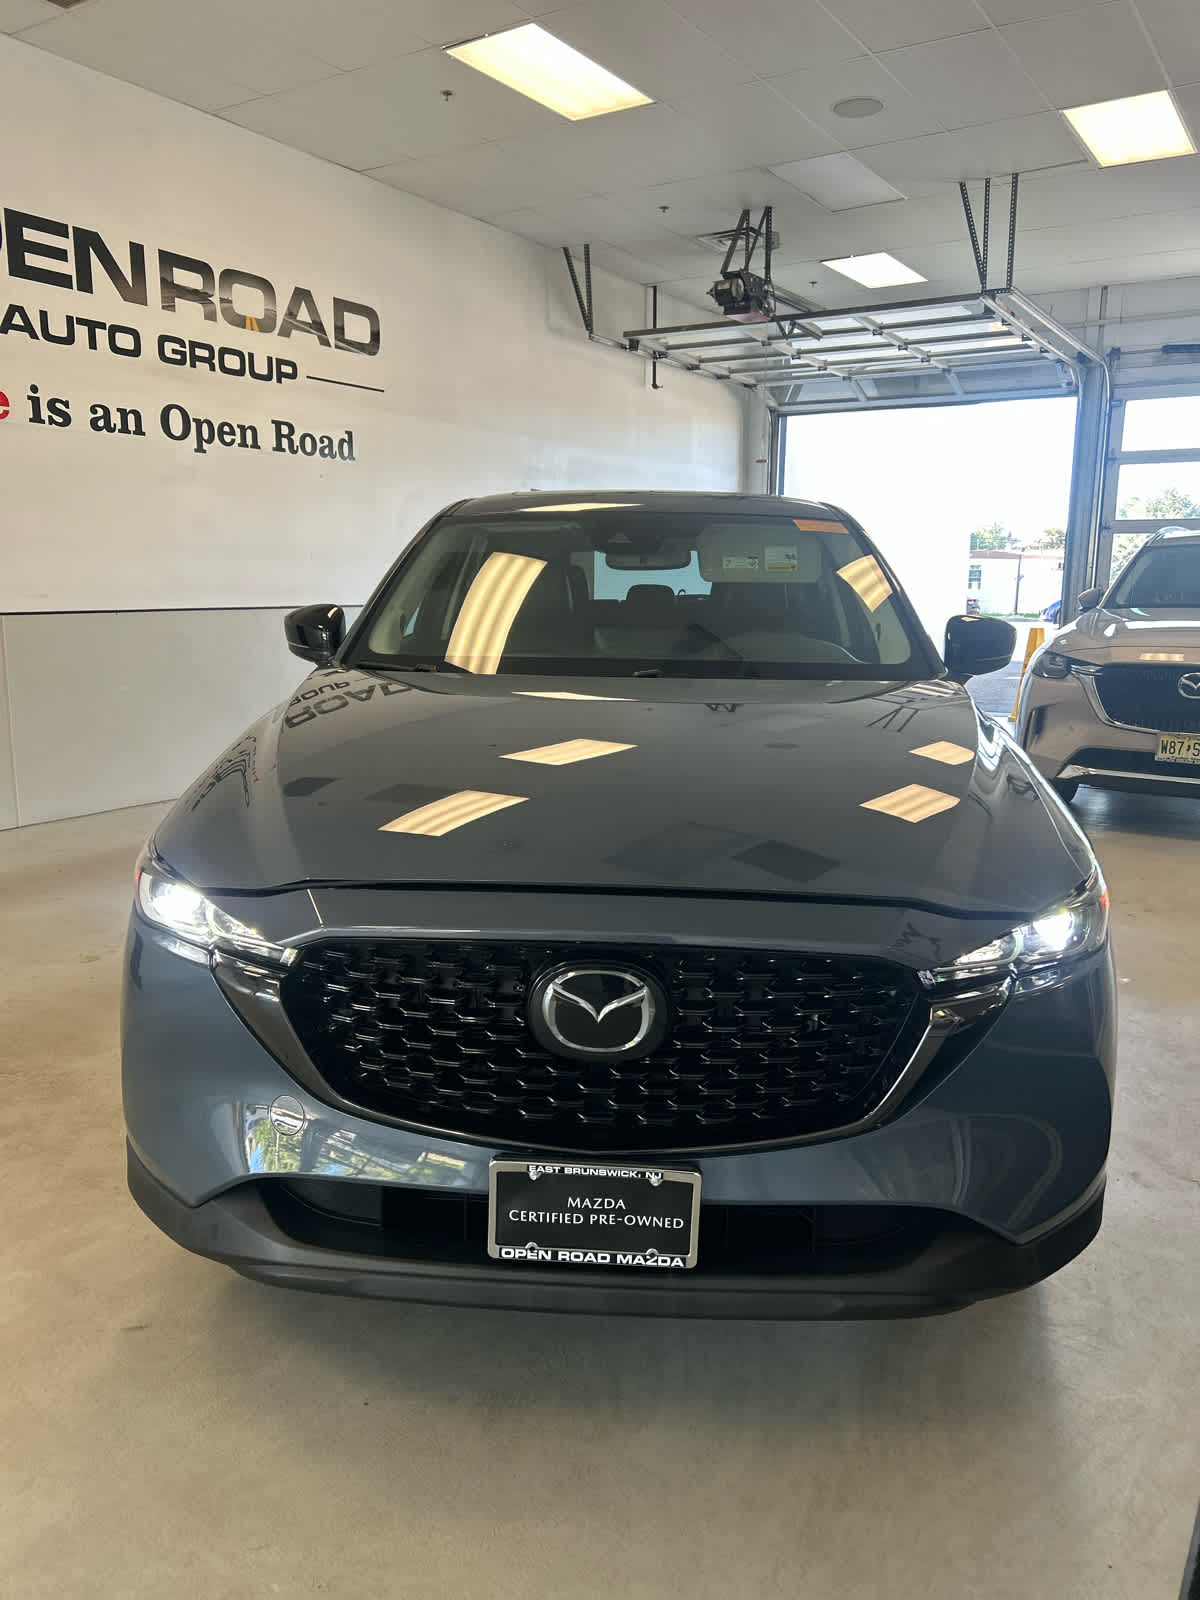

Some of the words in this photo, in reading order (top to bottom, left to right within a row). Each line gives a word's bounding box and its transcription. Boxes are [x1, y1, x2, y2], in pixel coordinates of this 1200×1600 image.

[0, 207, 148, 307] EN
[157, 248, 381, 356] ROAD
[0, 304, 142, 358] AUTO
[157, 334, 298, 384] GROUP
[26, 384, 72, 428] is
[89, 401, 146, 437] an
[160, 403, 261, 453] Open
[271, 419, 356, 461] Road
[528, 1165, 561, 1174] EAST
[564, 1167, 642, 1178] BRUNSWICK,
[645, 1171, 663, 1180] NJ
[567, 1197, 626, 1210] MAZDA
[508, 1209, 584, 1225] CERTIFIED
[589, 1214, 685, 1229] PRE-OWNED
[501, 1248, 552, 1260] OPEN
[557, 1251, 611, 1264] ROAD
[616, 1254, 685, 1268] MAZDA
